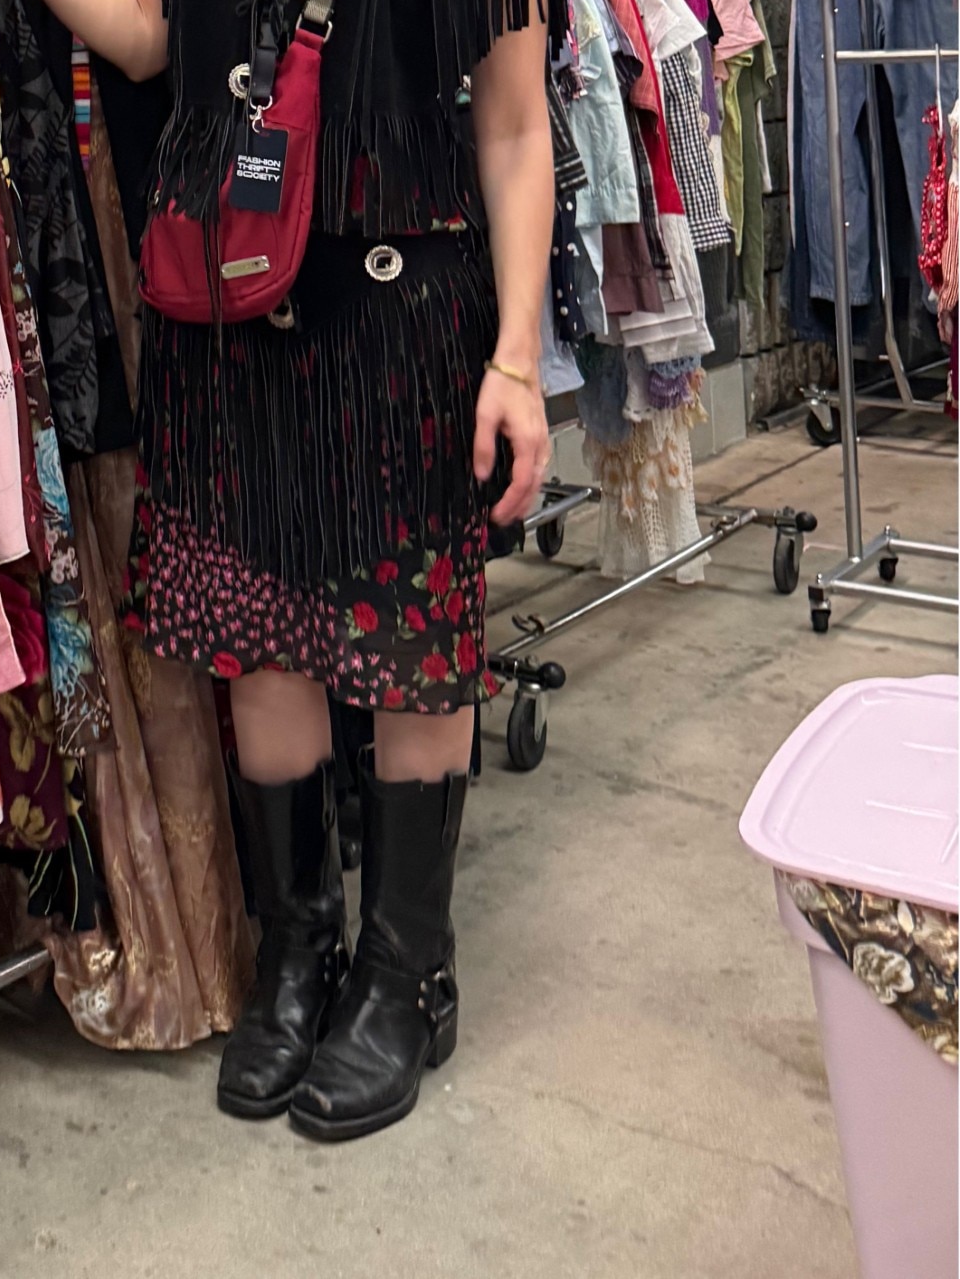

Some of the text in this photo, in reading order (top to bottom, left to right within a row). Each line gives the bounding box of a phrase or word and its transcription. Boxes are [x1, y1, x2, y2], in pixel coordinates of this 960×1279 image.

[236, 162, 280, 173] THRIFT
[237, 154, 281, 168] FASHION
[236, 170, 280, 183] SOCIETY
